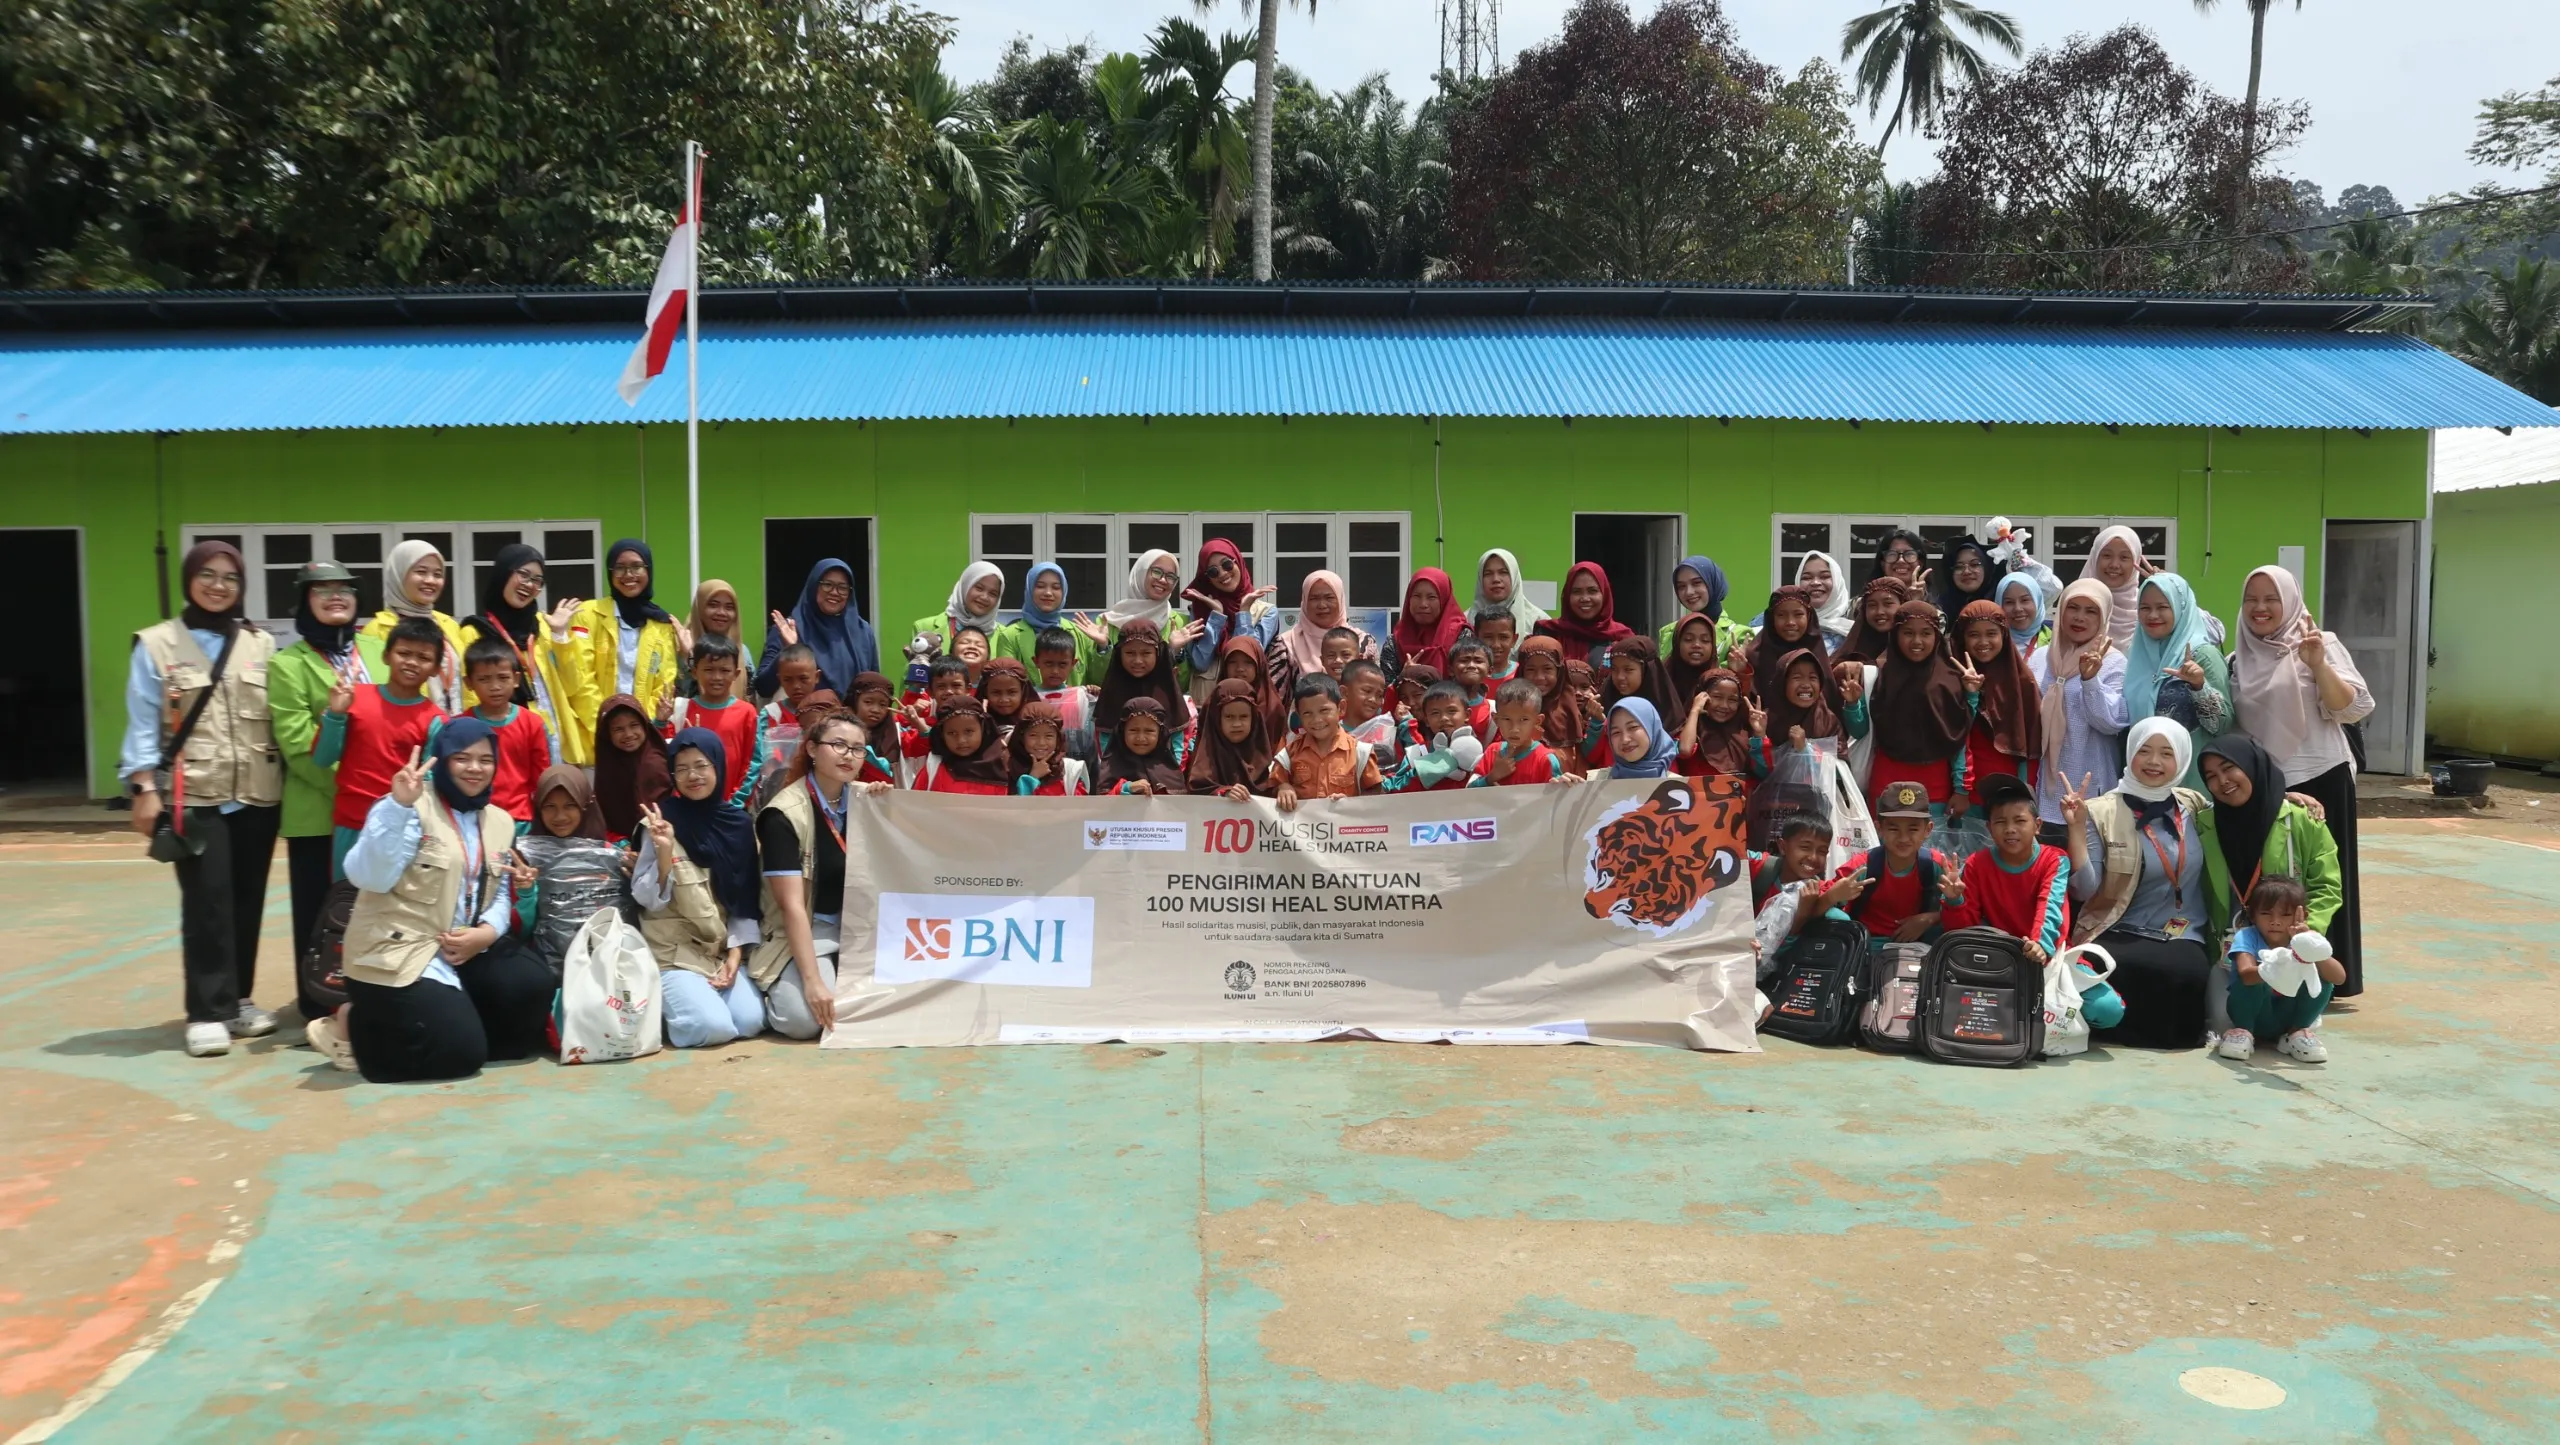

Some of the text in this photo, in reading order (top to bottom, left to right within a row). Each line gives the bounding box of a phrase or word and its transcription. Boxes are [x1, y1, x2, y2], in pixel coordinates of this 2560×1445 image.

[1203, 818, 1255, 853] 100
[1258, 819, 1334, 840] MUSISI
[1411, 820, 1495, 844] RANS
[1259, 840, 1389, 854] HEAL SUMATRA
[934, 876, 1024, 888] SPONSORED BY:
[1167, 872, 1421, 890] PENGIRIMAN BANTUAN
[1146, 894, 1443, 913] 100 MUSISI HEAL SUMATRA
[1162, 918, 1424, 932] Hasil solidaritas musisi, publik, dan masyarakat Indonesia
[961, 917, 1067, 964] BNI
[1204, 930, 1384, 942] untuk saudara-saudara kita di Sumatra
[1264, 980, 1367, 988] BANK BNI 2025807896
[1282, 989, 1302, 997] Iluni
[1304, 989, 1314, 997] UI
[2043, 1010, 2056, 1024] 00
